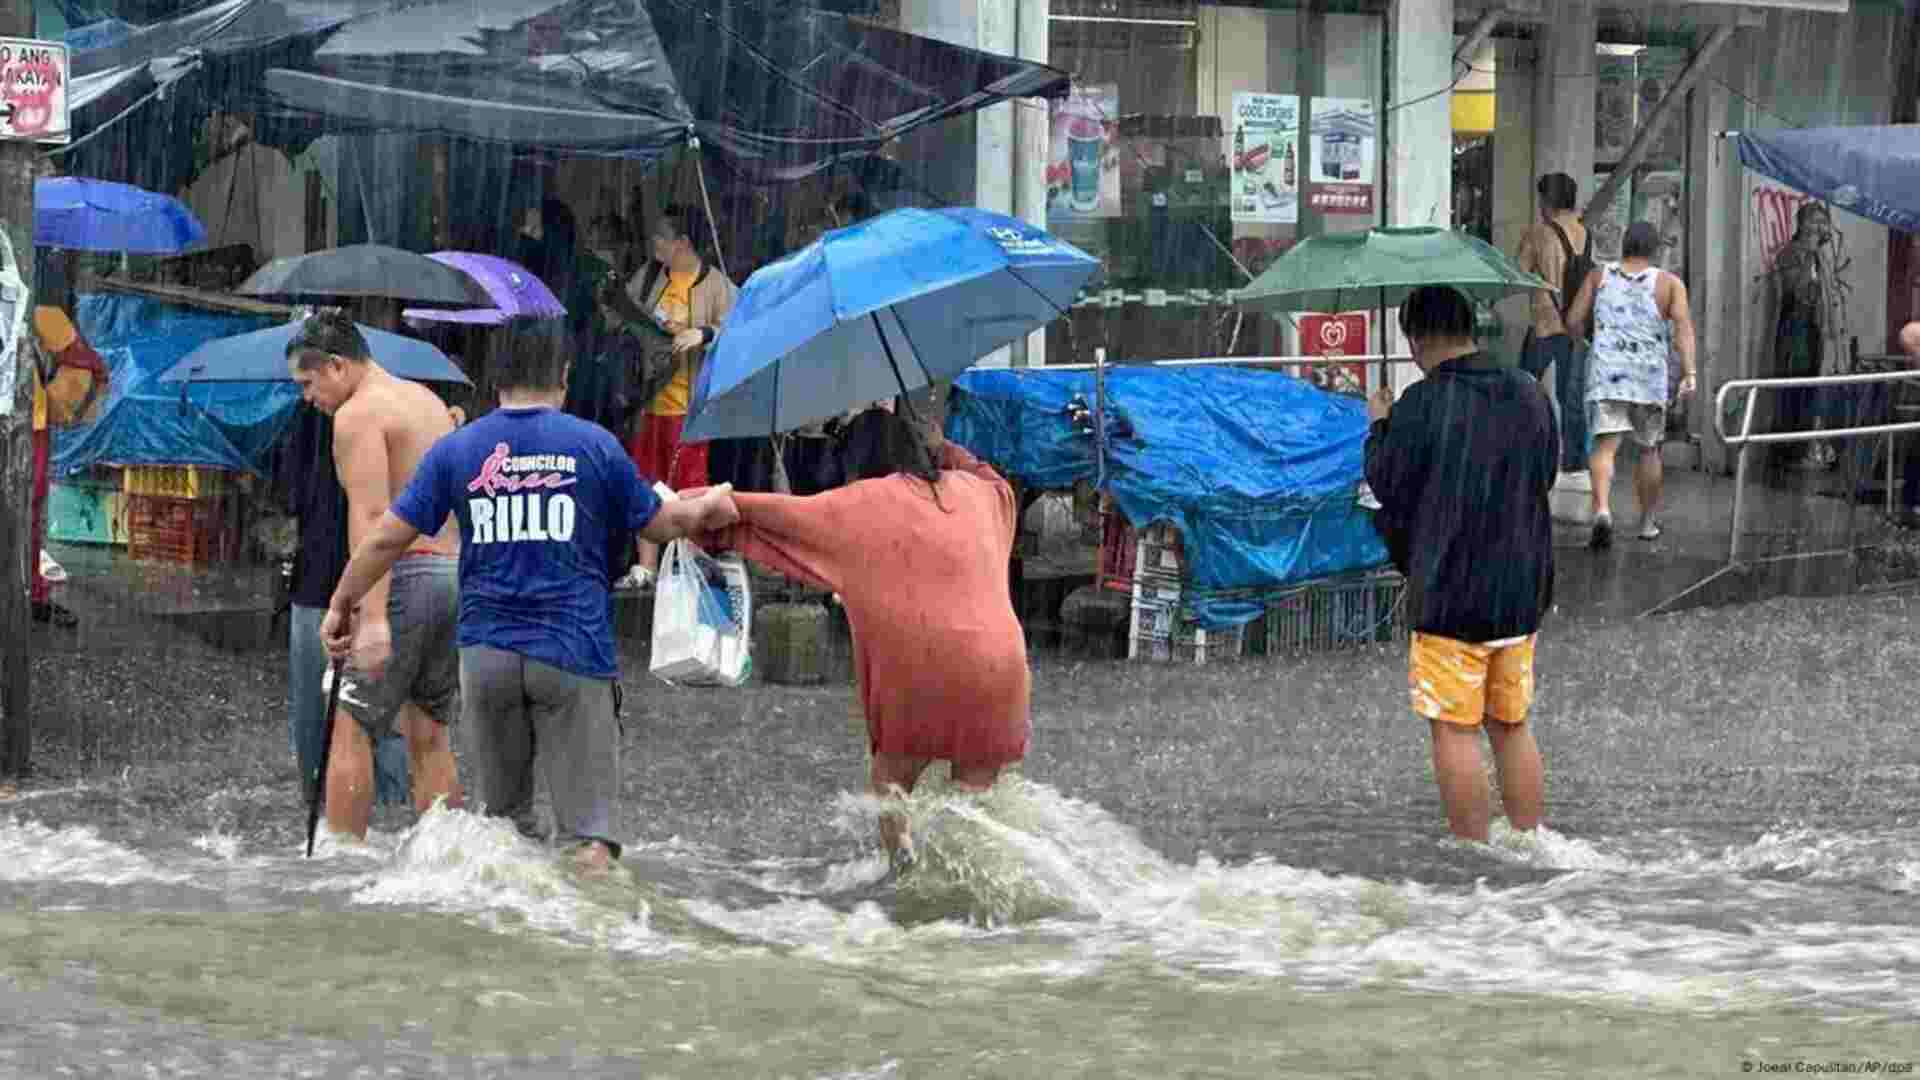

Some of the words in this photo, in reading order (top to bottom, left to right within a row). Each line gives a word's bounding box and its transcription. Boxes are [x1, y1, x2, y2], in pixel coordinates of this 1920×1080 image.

[19, 48, 50, 64] ANG
[502, 454, 576, 473] COUNCILOR
[468, 493, 575, 544] RILLO
